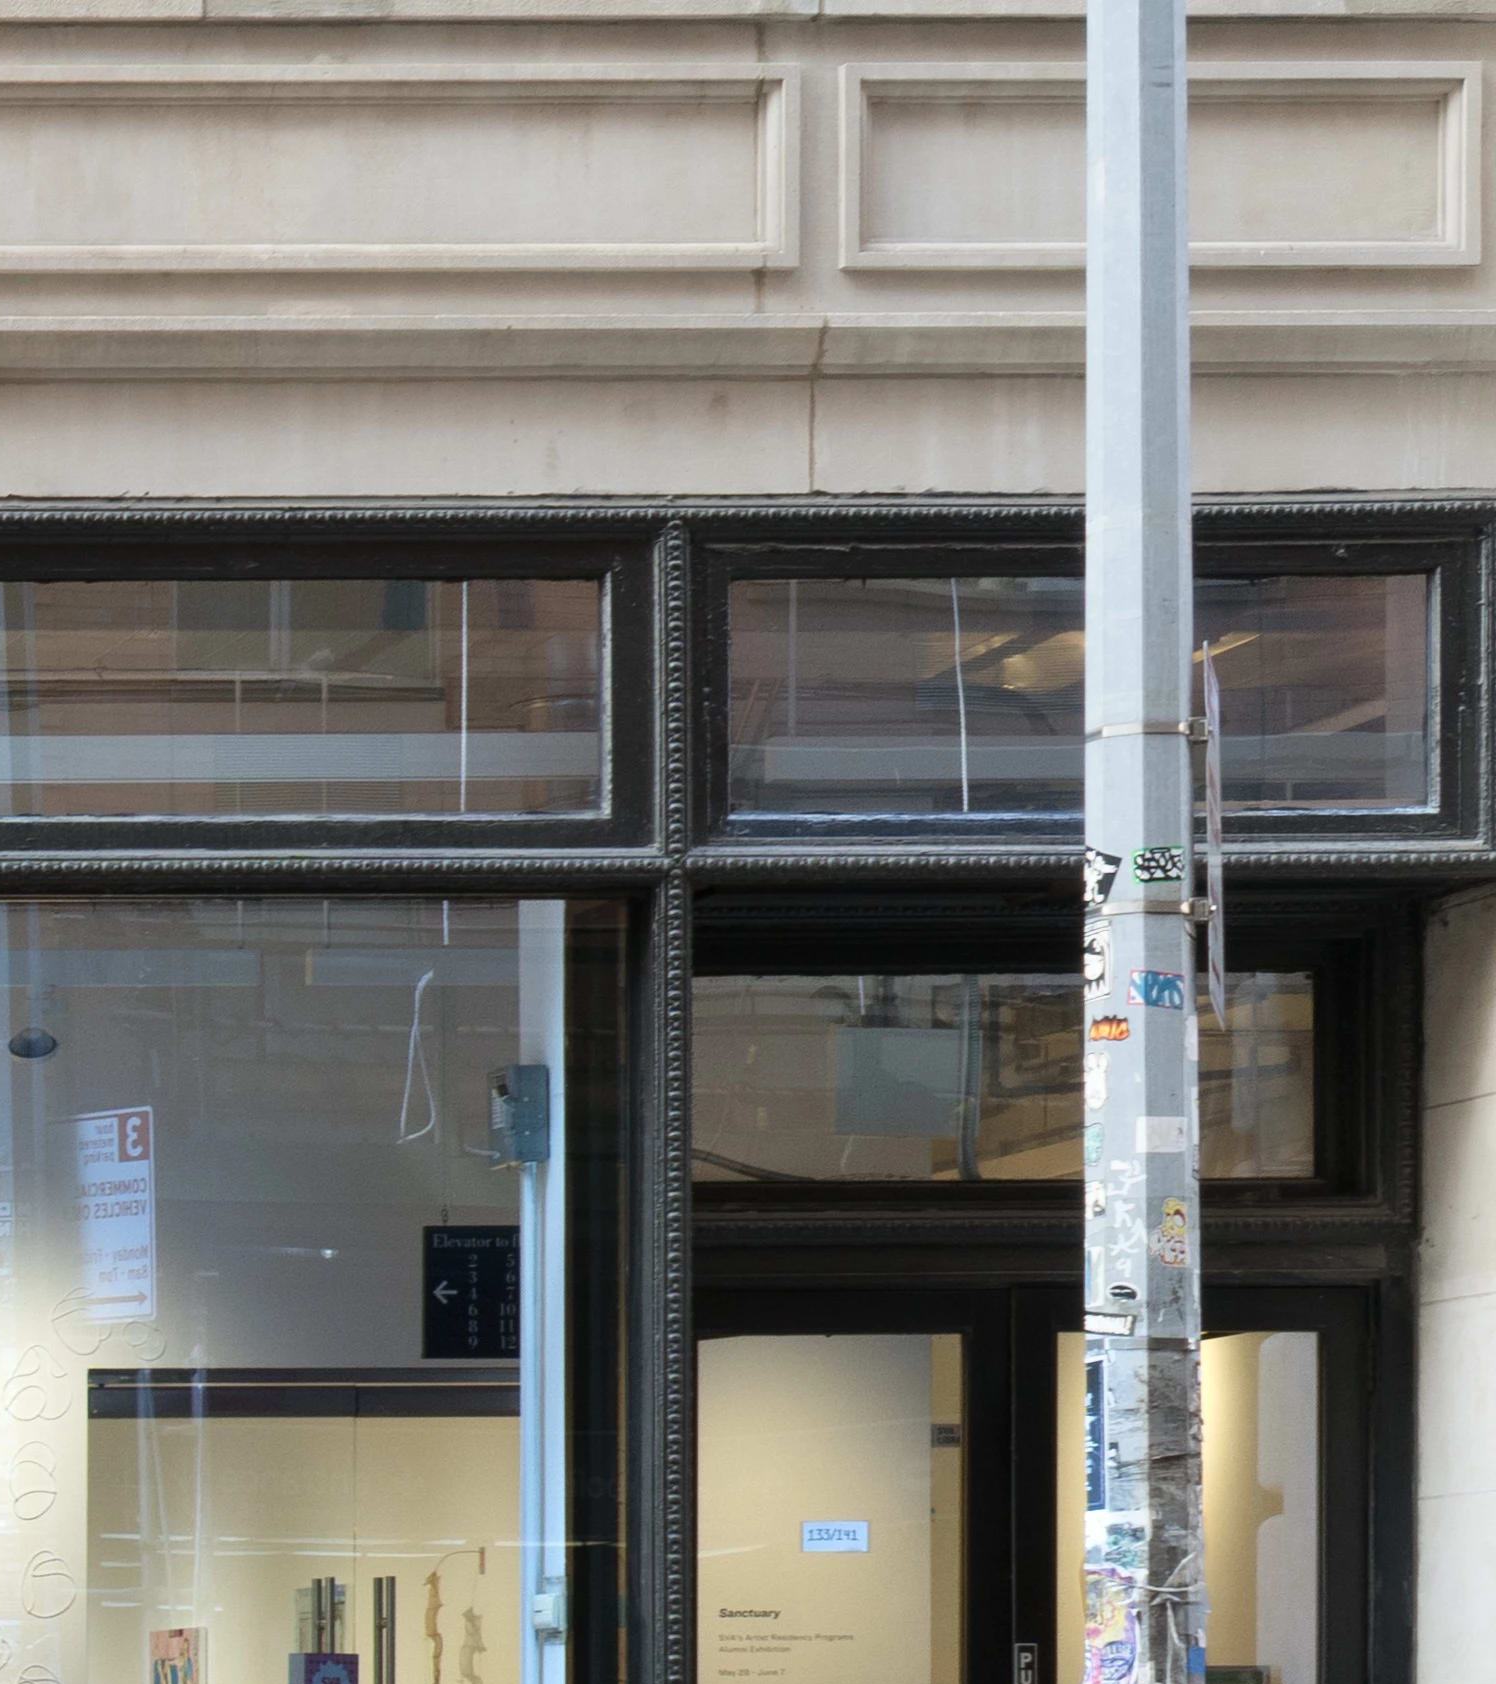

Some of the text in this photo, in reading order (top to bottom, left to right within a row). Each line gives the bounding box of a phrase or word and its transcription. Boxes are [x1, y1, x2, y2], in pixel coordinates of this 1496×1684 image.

[433, 1233, 491, 1248] Elevator
[495, 1237, 509, 1248] to
[719, 1608, 781, 1619] Sanctuary
